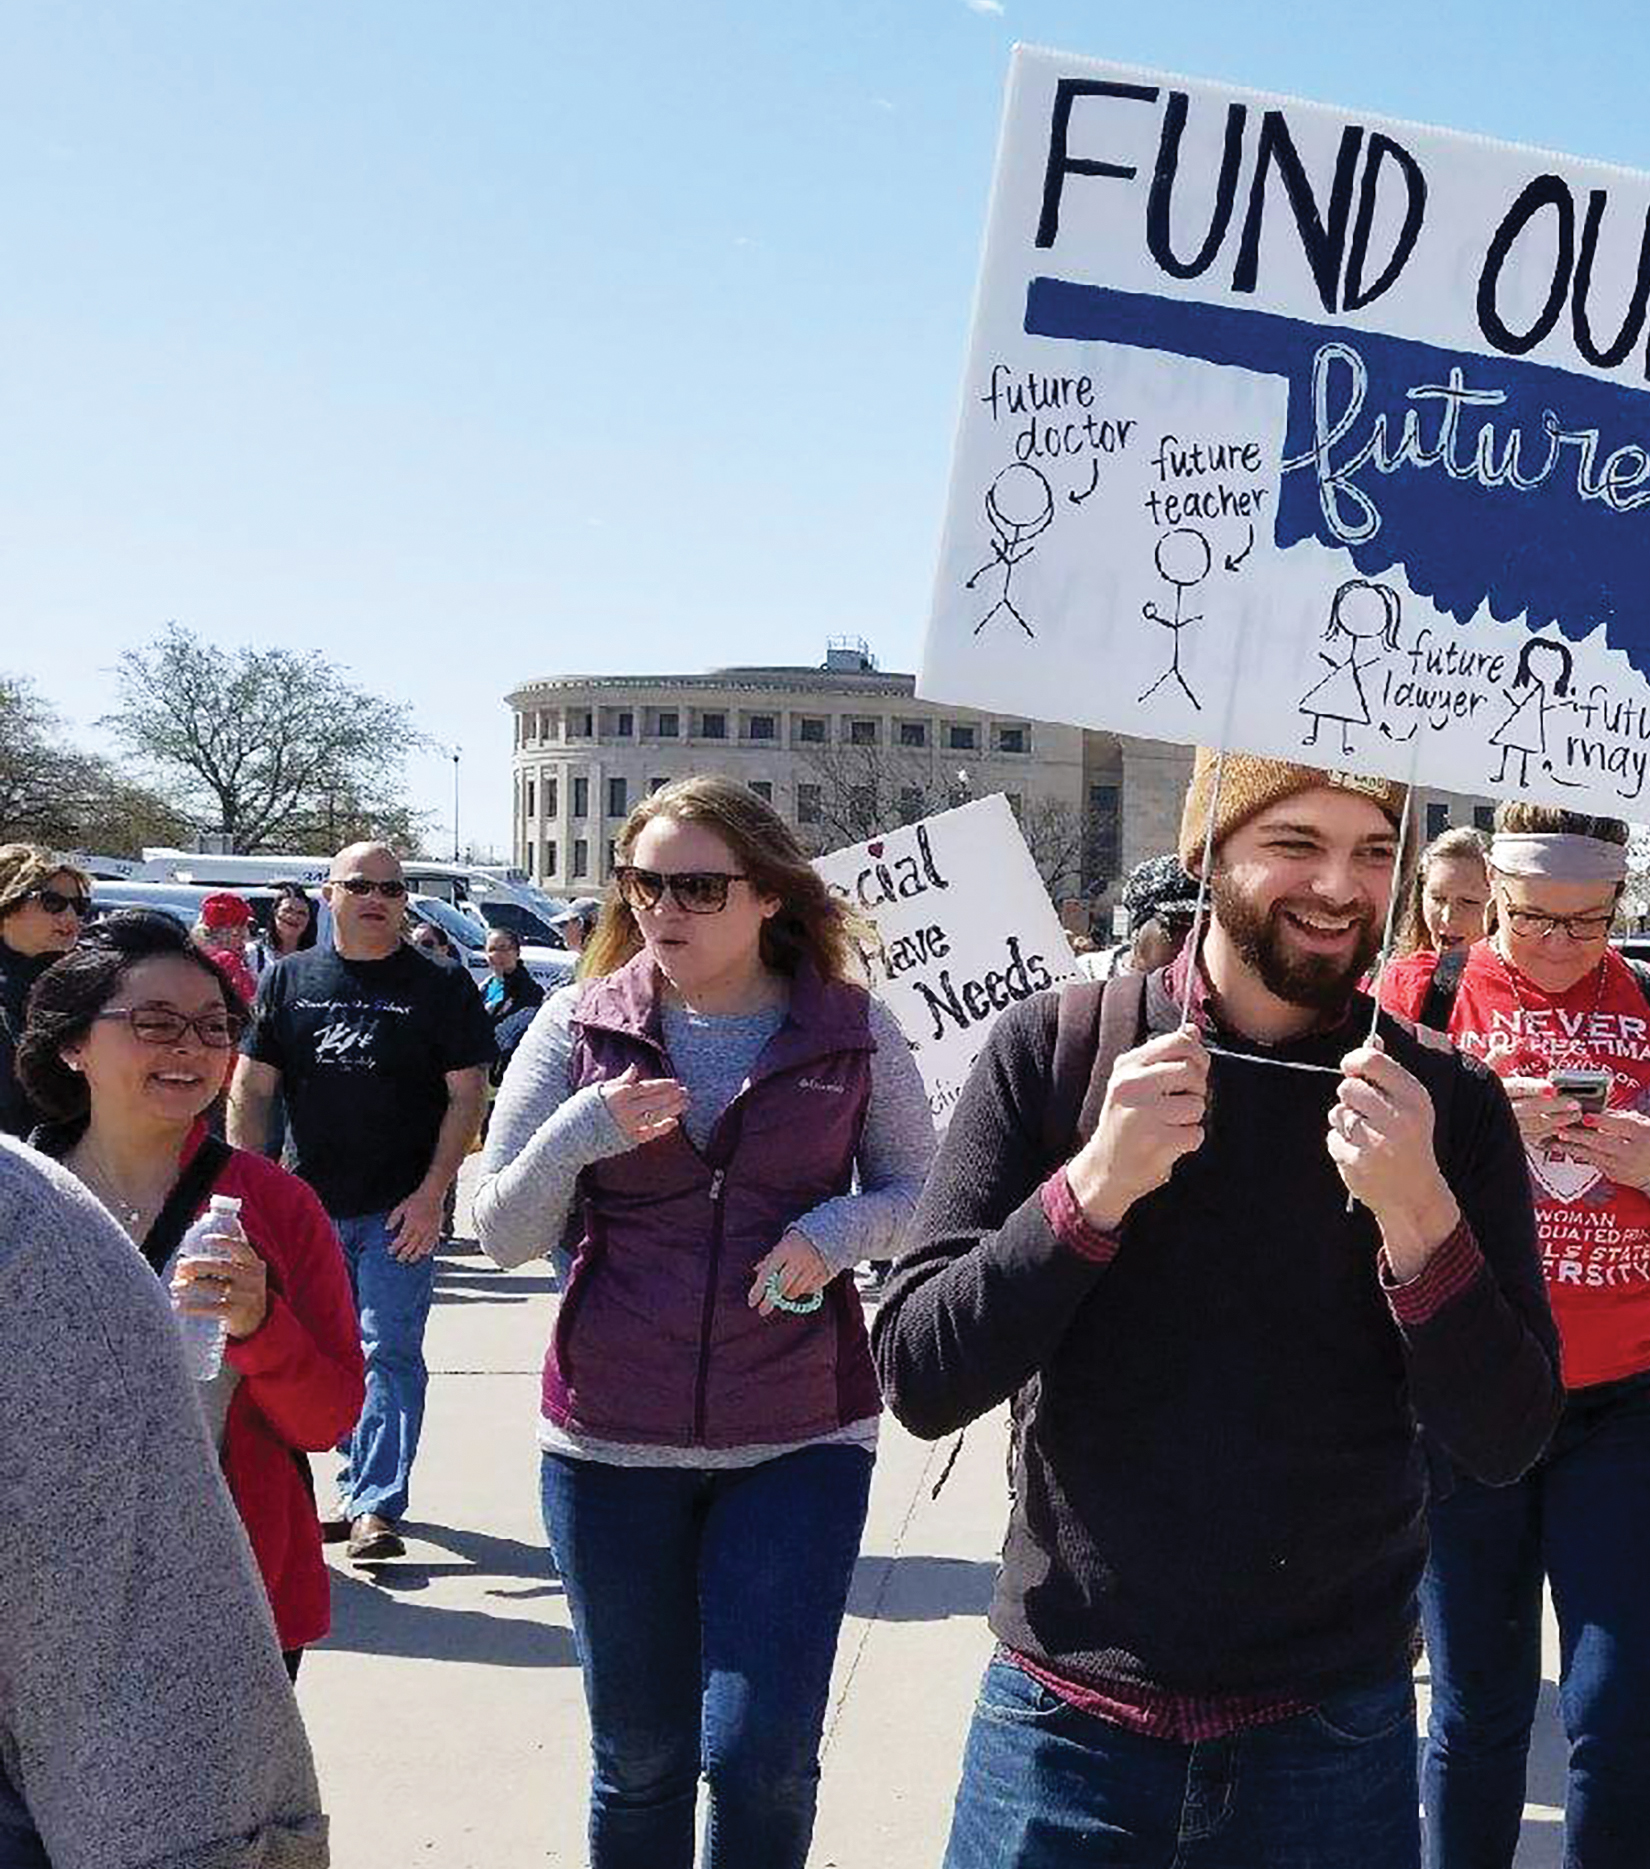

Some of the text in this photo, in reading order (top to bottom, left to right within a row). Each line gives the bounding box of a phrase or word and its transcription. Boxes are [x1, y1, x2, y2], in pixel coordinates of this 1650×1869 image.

[1036, 77, 1428, 315] FUND
[982, 364, 1095, 423] future
[1015, 416, 1139, 461] doctor
[1150, 434, 1263, 482] future
[1144, 485, 1270, 524] teacher
[1407, 629, 1507, 684] future
[1381, 671, 1488, 732] lawyer
[1491, 1007, 1647, 1041] NEVER
[1534, 1207, 1616, 1228] WOMAN
